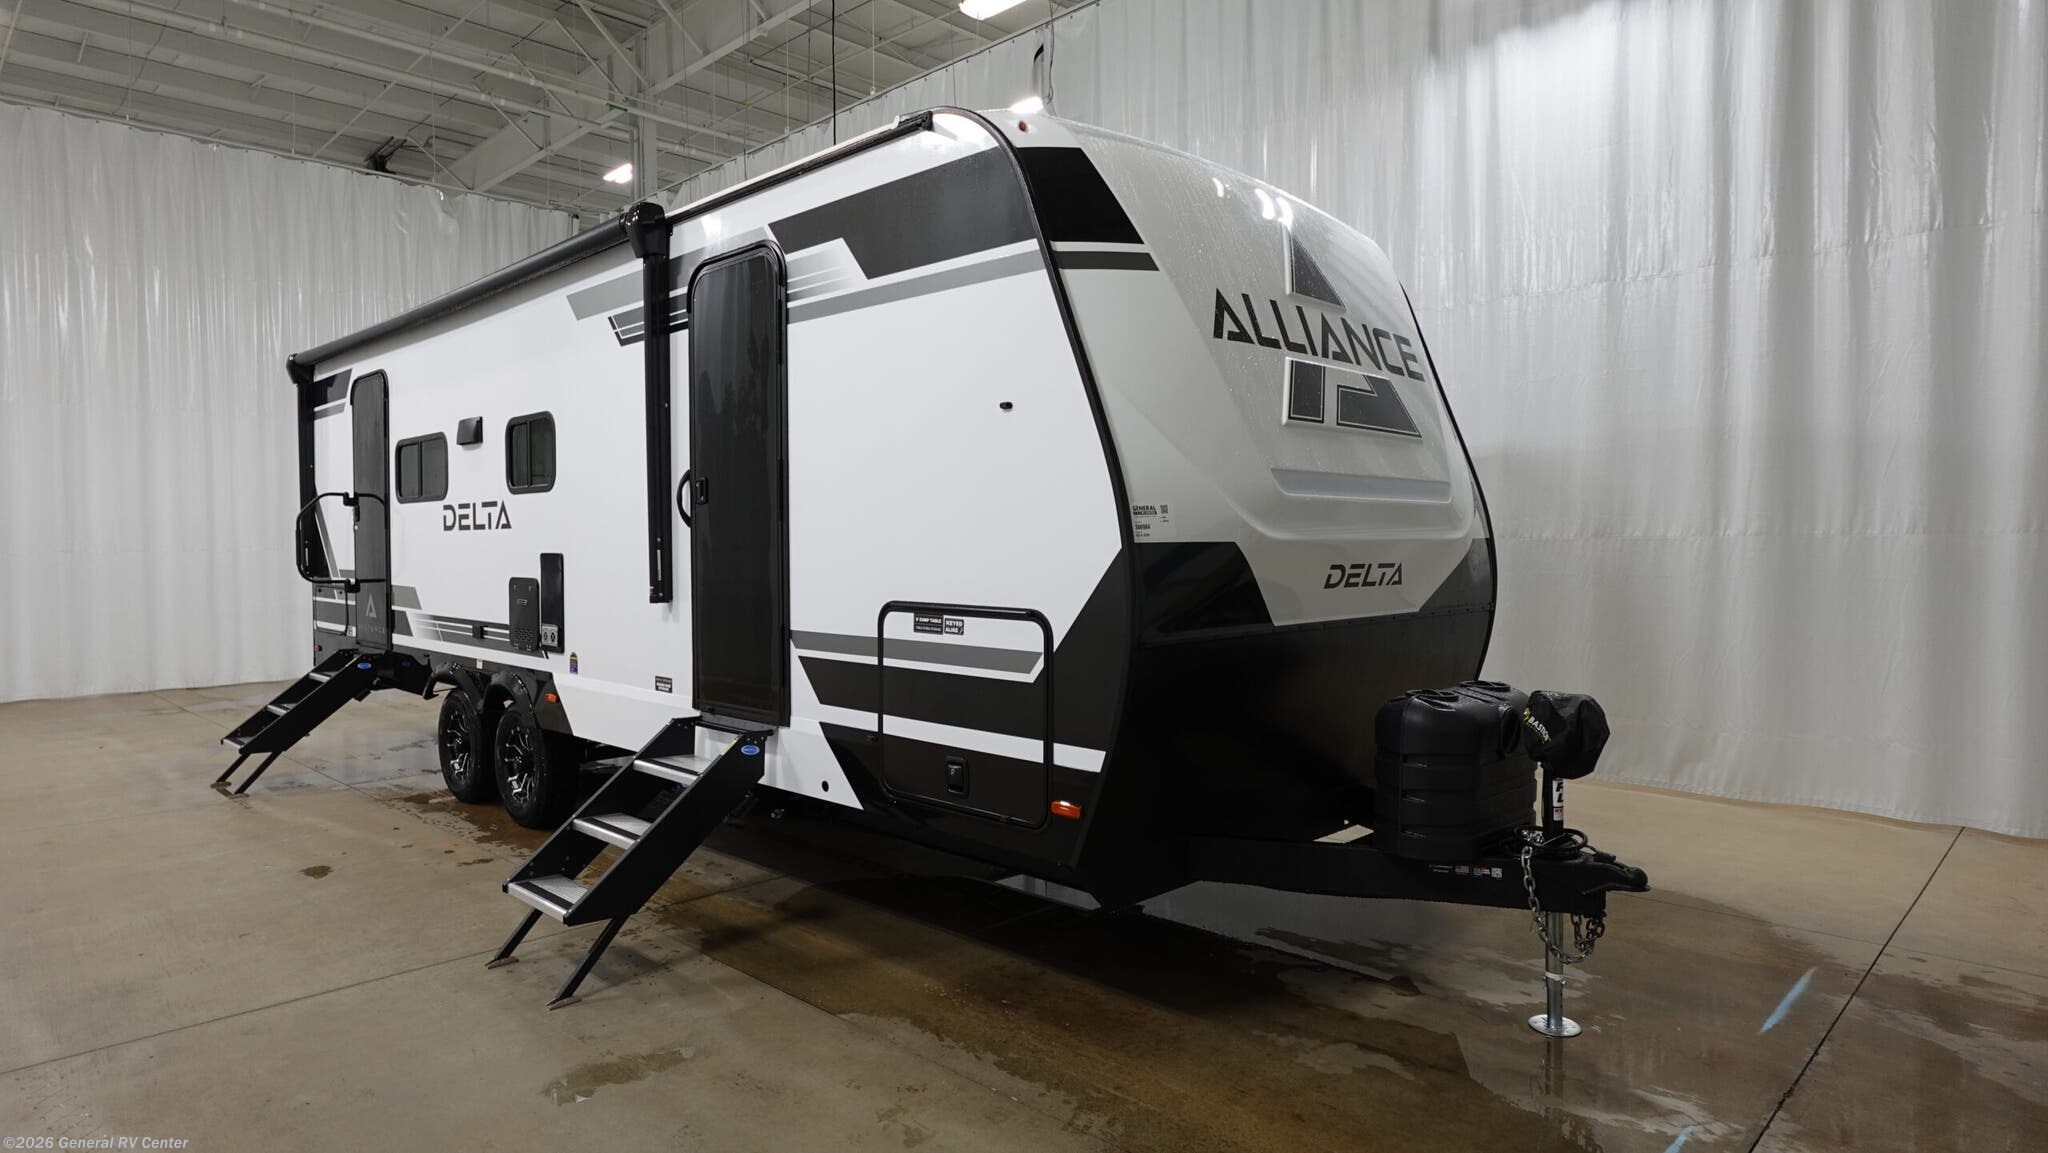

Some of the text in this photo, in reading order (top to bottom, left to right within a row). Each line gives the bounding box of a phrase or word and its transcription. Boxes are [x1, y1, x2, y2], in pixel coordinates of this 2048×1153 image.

[1212, 287, 1425, 382] ALLIANCE
[443, 500, 512, 531] DELTA
[1323, 562, 1403, 589] DELTA
